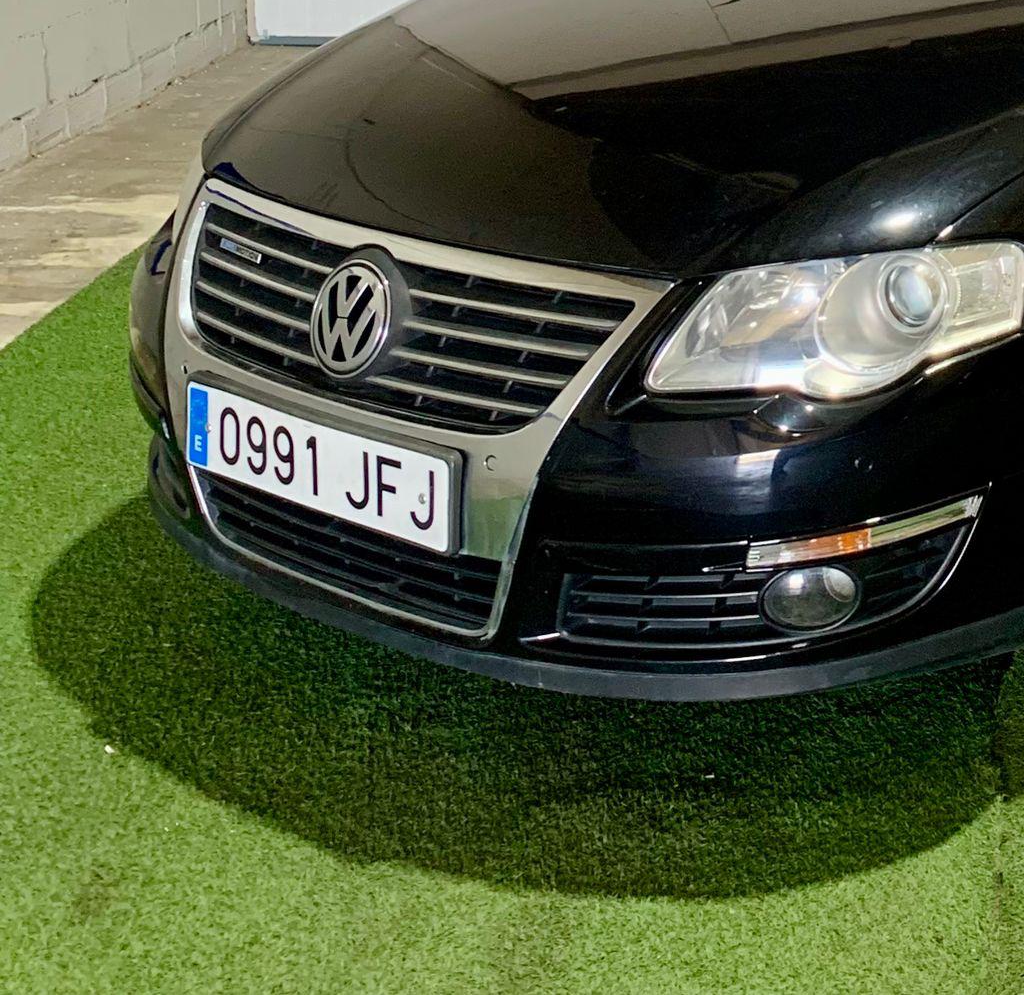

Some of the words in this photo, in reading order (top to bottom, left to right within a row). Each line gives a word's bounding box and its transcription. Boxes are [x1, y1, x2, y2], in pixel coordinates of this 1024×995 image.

[194, 433, 203, 453] E
[219, 406, 319, 497] 0991
[345, 451, 435, 531] JFJ
